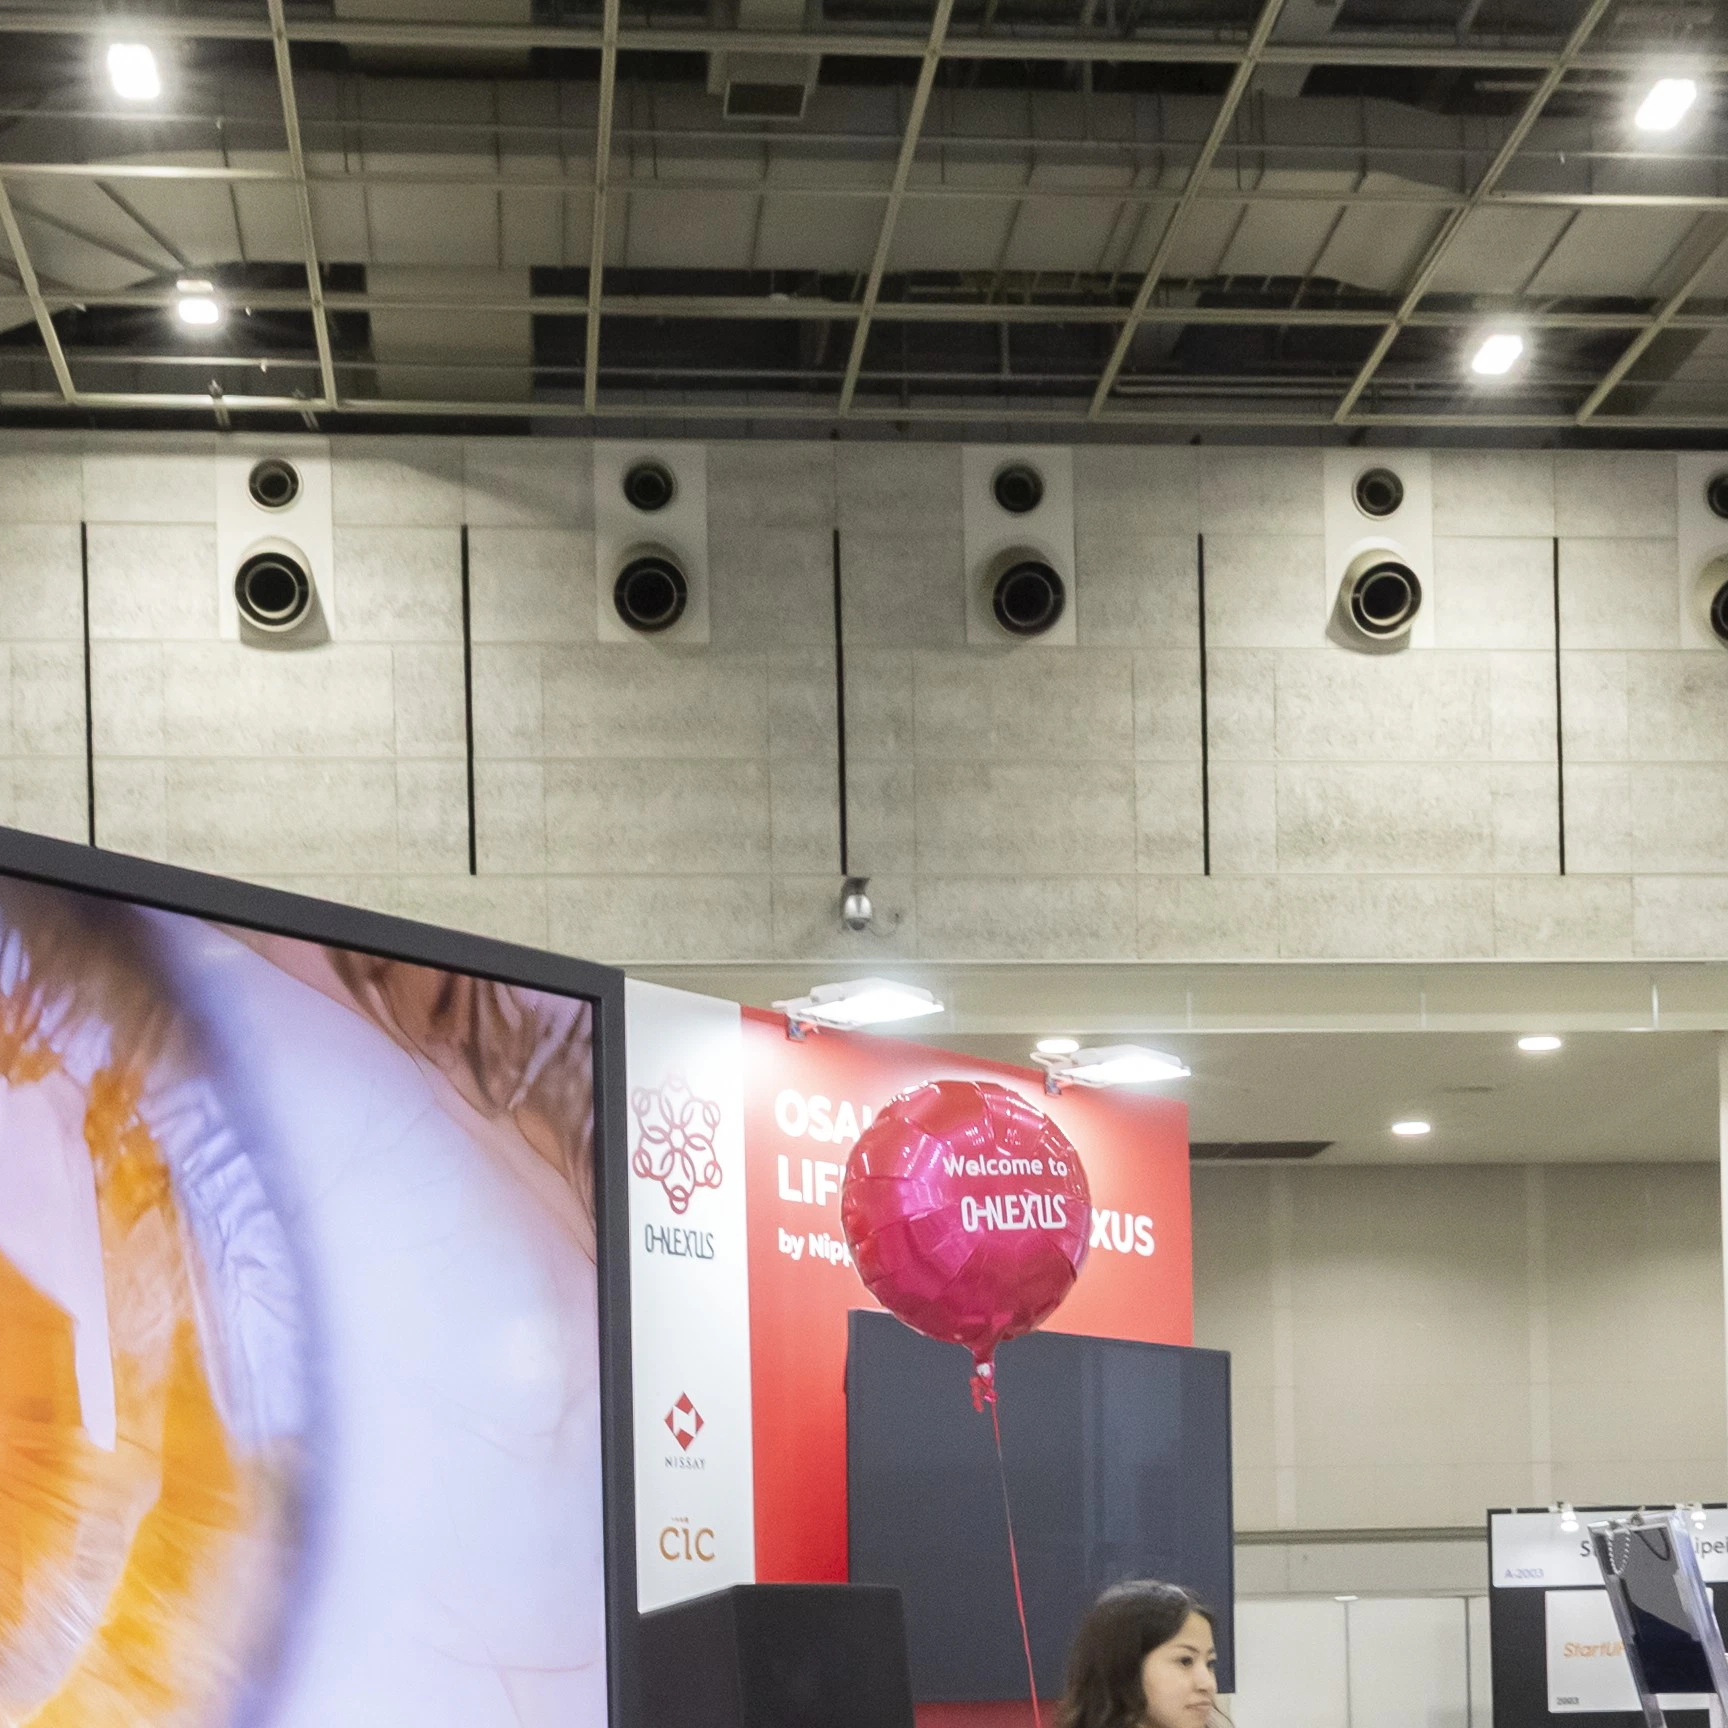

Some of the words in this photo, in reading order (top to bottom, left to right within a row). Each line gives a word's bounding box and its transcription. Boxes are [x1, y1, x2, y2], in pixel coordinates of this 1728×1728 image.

[777, 1154, 846, 1206] LIF
[942, 1154, 1043, 1179] Welcome
[1048, 1157, 1069, 1178] to
[778, 1227, 806, 1261] by
[664, 1456, 706, 1470] NISSAY
